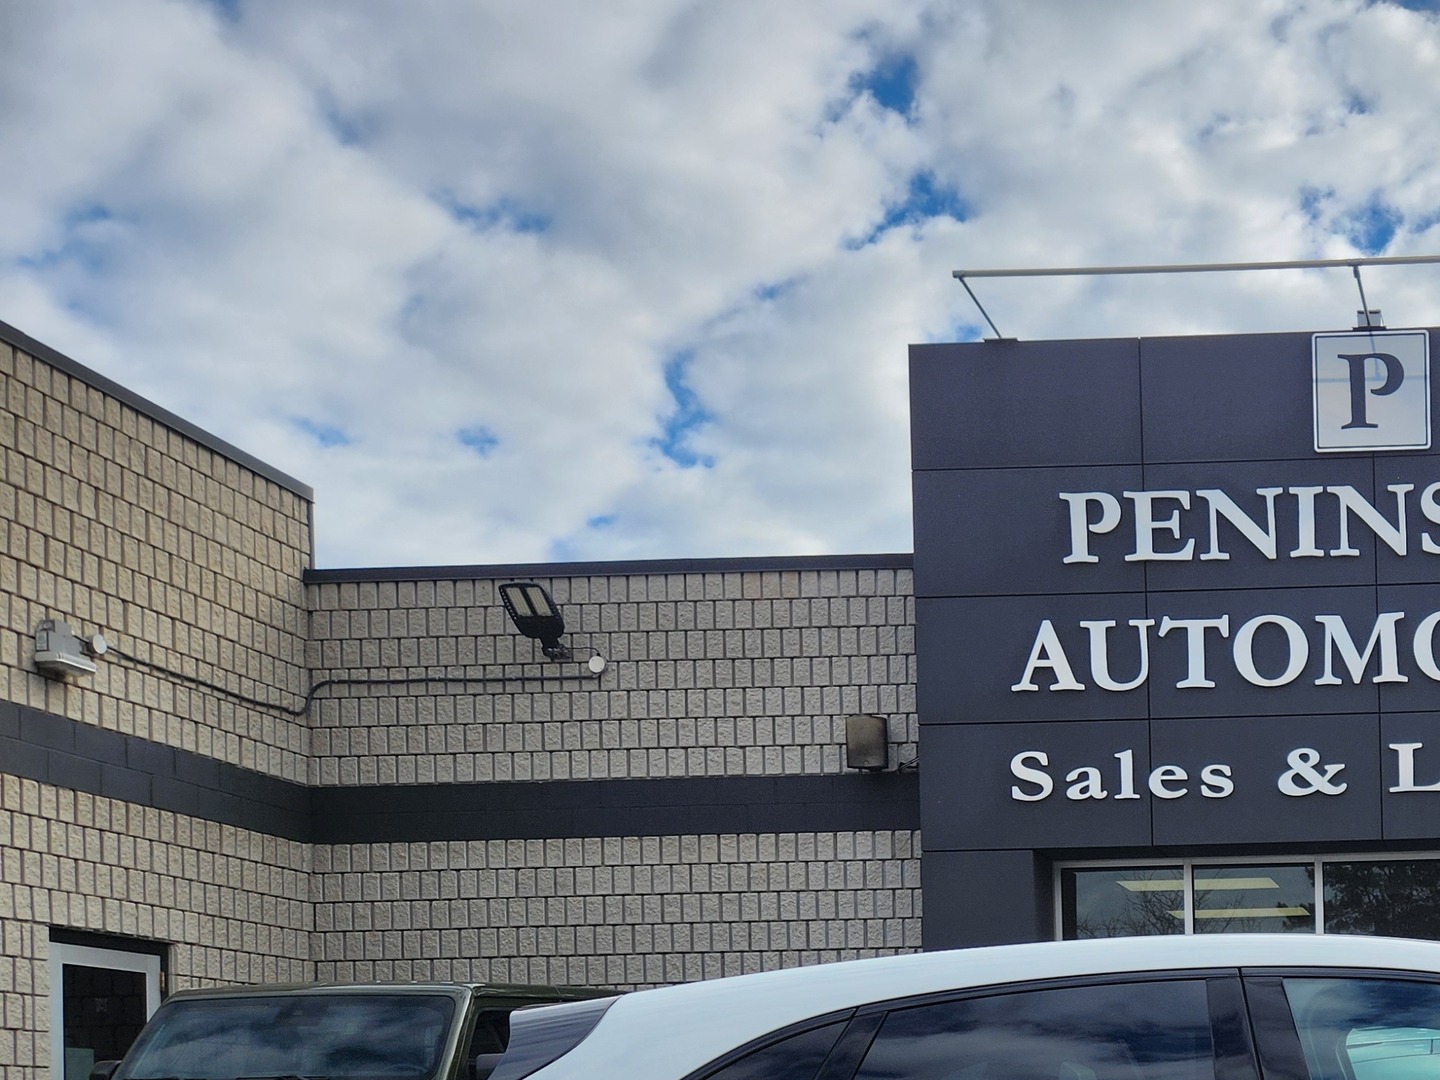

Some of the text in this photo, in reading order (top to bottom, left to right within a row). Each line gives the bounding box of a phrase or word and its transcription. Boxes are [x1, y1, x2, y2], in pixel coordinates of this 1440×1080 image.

[1337, 352, 1405, 431] P
[1009, 749, 1235, 803] Sales
[1276, 747, 1348, 797] &
